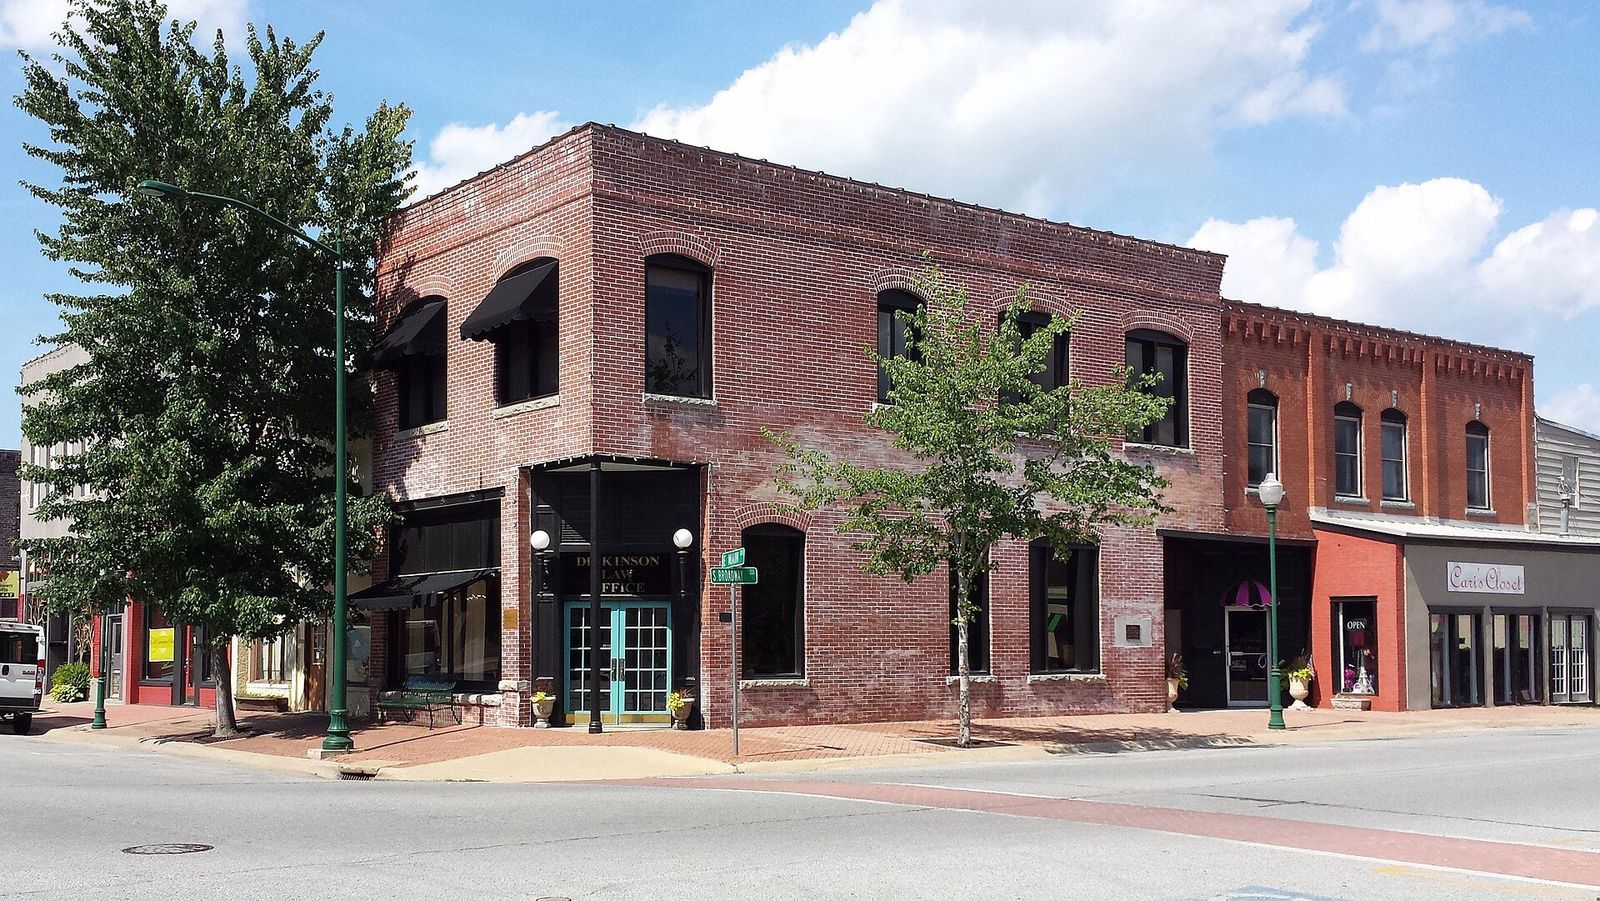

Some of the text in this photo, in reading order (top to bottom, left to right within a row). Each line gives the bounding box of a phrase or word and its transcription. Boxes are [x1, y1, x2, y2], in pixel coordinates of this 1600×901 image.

[577, 556, 660, 566] DIKINSON
[601, 569, 633, 580] LAW
[712, 569, 717, 582] S
[717, 569, 744, 582] BROADWAY
[1450, 565, 1521, 591] Cari's Closet
[601, 582, 645, 593] FFICE
[1347, 620, 1365, 629] OPEN
